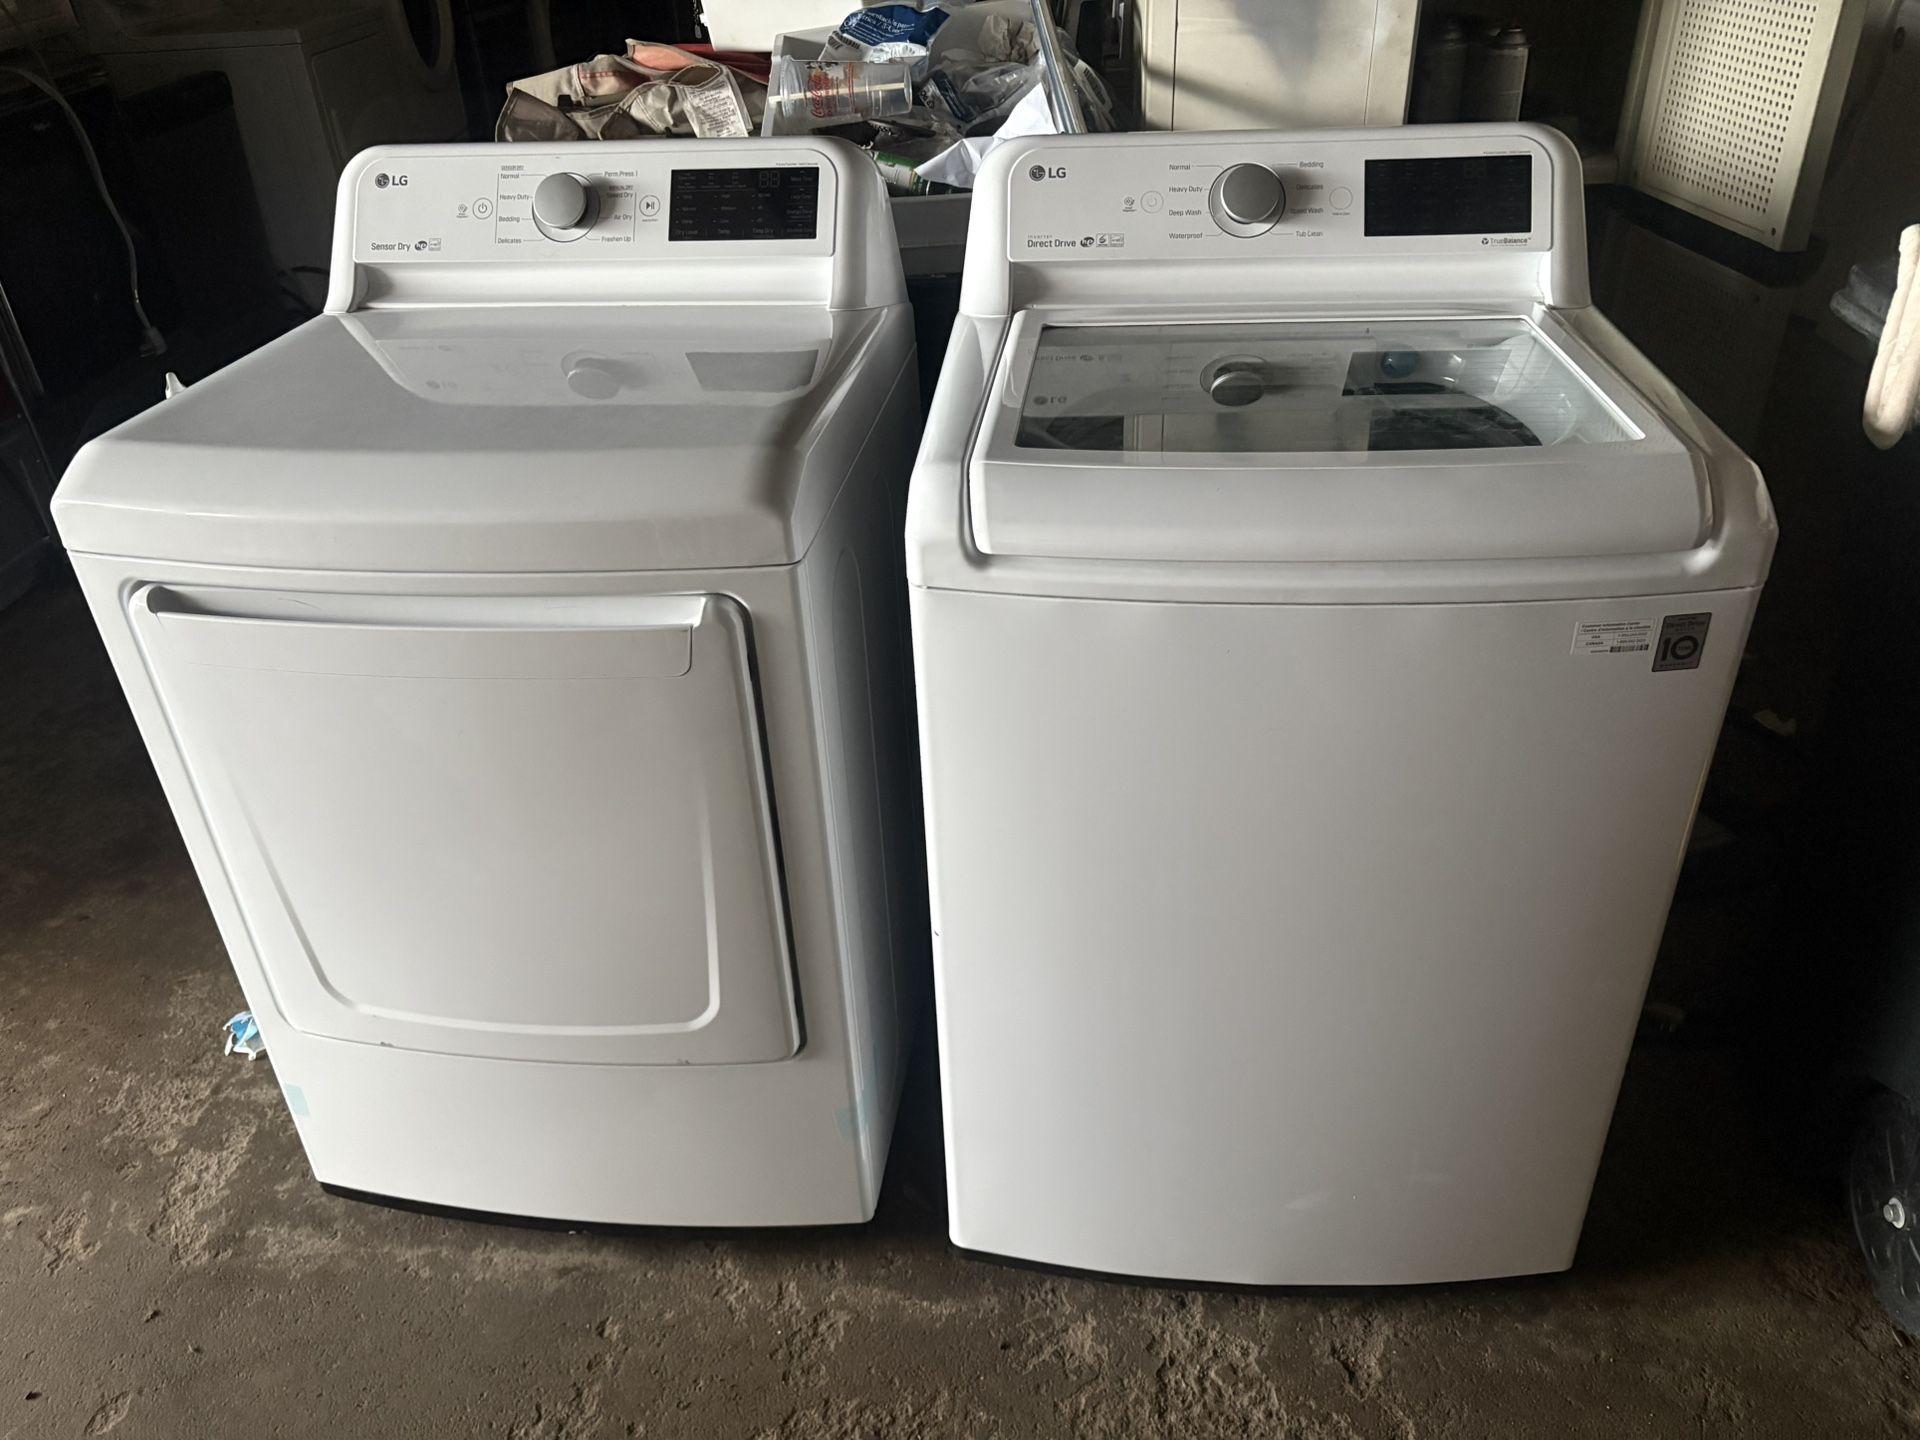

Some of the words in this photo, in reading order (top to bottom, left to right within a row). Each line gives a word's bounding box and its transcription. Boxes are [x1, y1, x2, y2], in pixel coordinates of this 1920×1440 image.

[1048, 167, 1067, 179] LG
[391, 175, 409, 187] LG
[1188, 185, 1203, 193] Duty
[623, 191, 633, 199] Dry
[622, 213, 632, 221] Dry
[1168, 209, 1183, 217] Deep
[1169, 232, 1203, 240] Waterproof
[371, 242, 396, 251] Sensor
[397, 242, 411, 253] Dry
[1027, 239, 1053, 248] Direct
[1054, 239, 1077, 247] Drive
